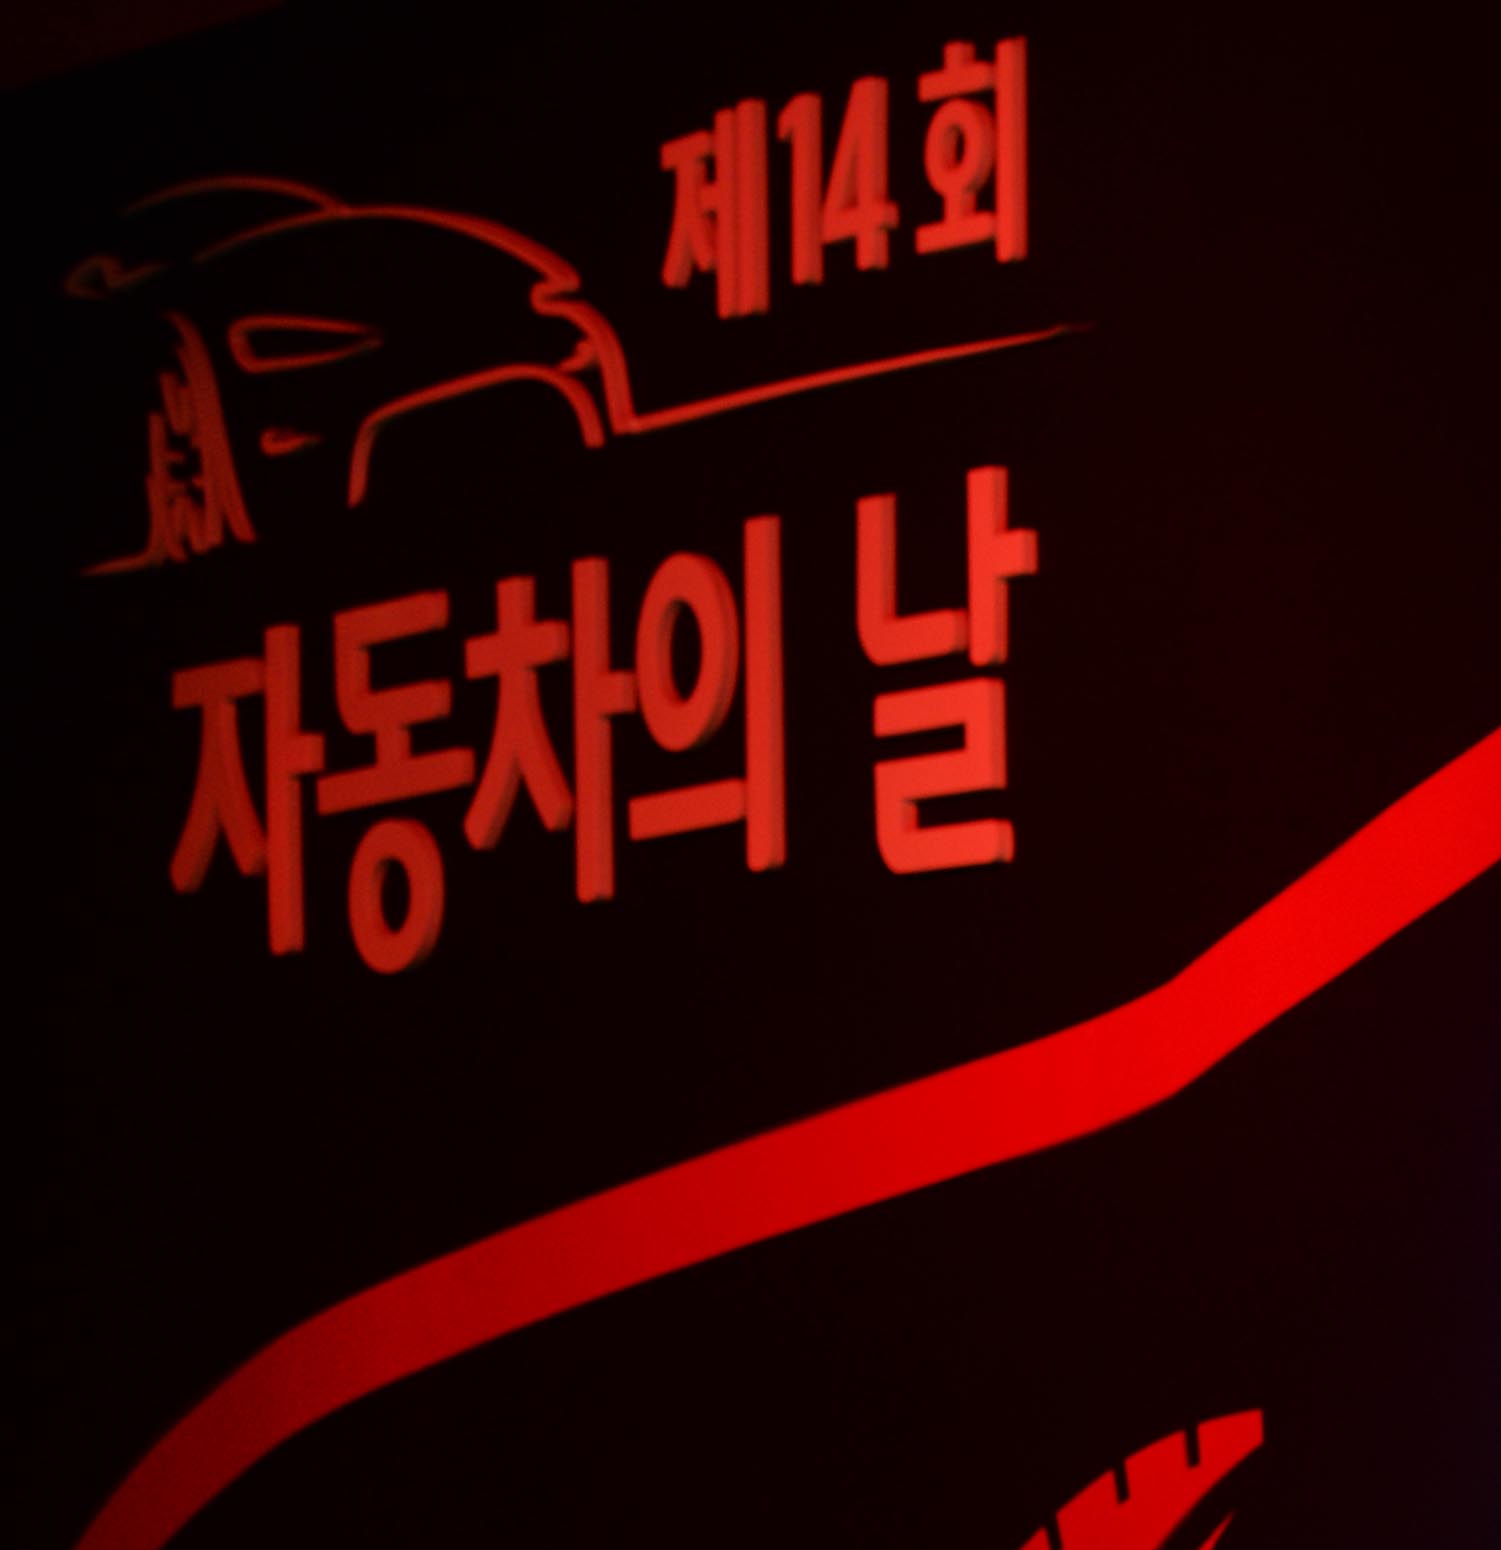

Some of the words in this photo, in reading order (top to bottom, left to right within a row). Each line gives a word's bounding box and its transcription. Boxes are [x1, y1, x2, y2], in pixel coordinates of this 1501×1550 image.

[661, 36, 1028, 319] 제14회
[169, 514, 787, 974] 자동차의
[856, 465, 1039, 875] 날
